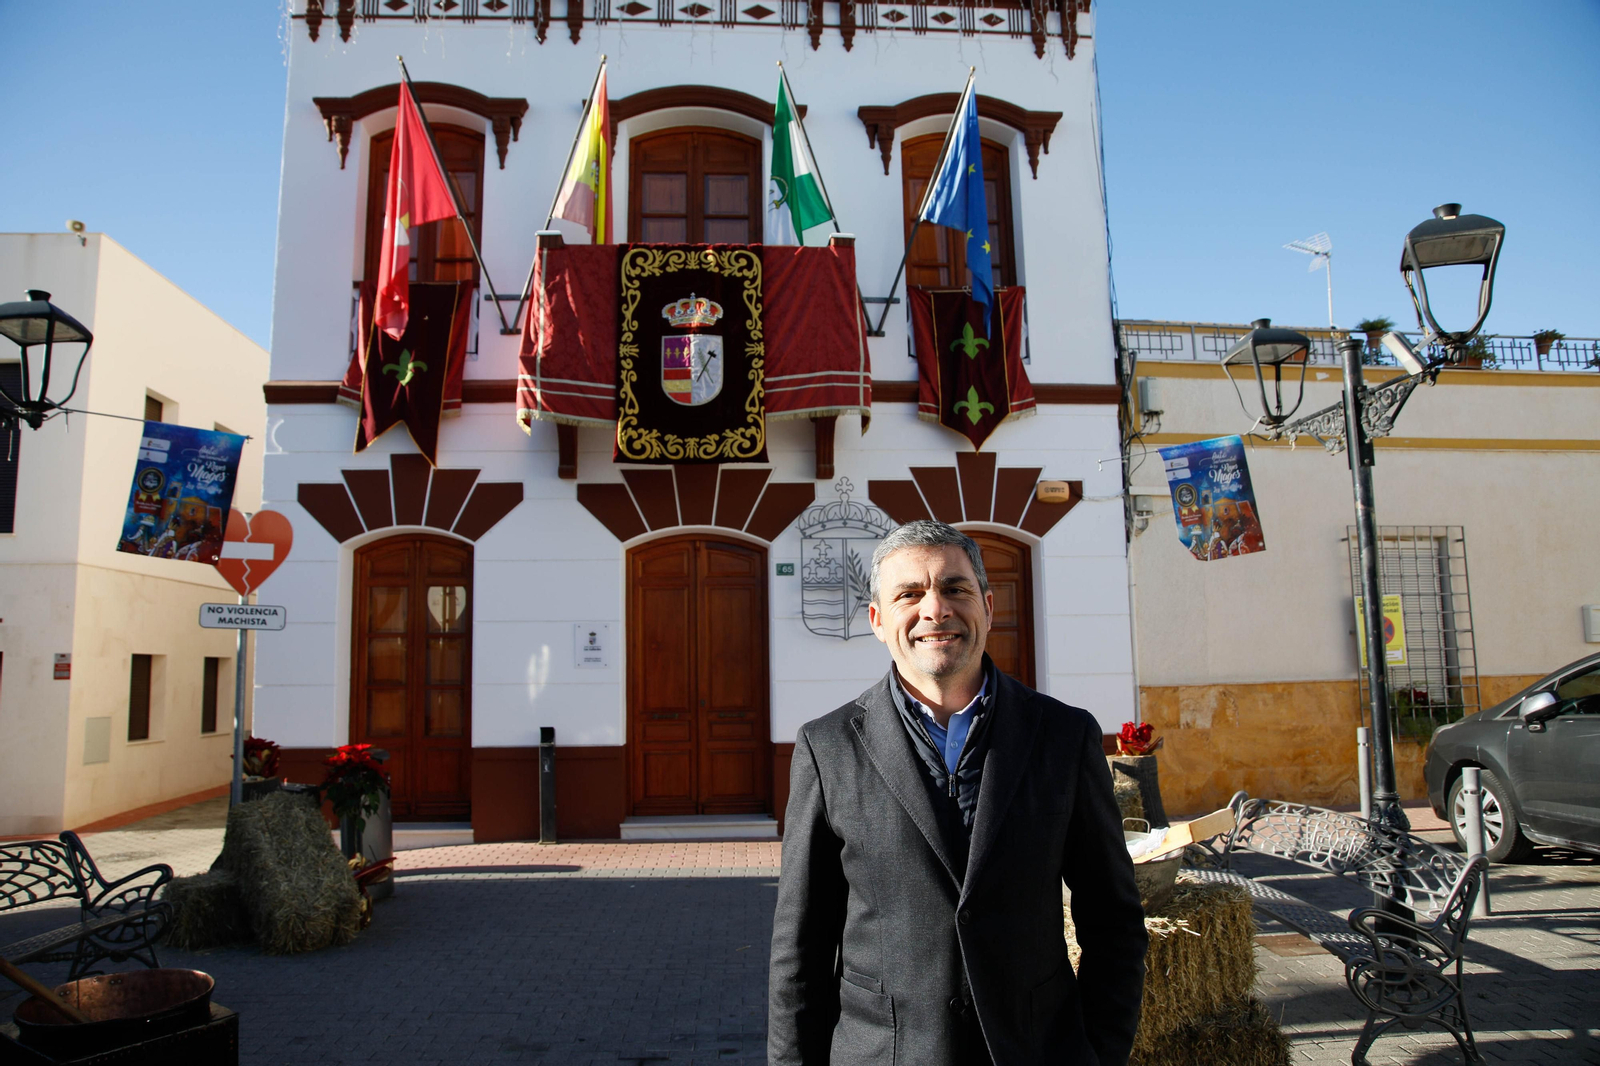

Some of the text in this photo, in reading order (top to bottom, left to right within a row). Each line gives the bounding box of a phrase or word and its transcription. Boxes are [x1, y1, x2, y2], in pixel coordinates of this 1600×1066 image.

[187, 462, 226, 484] Magos
[1208, 468, 1241, 484] Magos
[782, 565, 793, 573] 65
[207, 606, 279, 616] NO VIOLENCIA
[217, 617, 267, 626] MACHISTA
